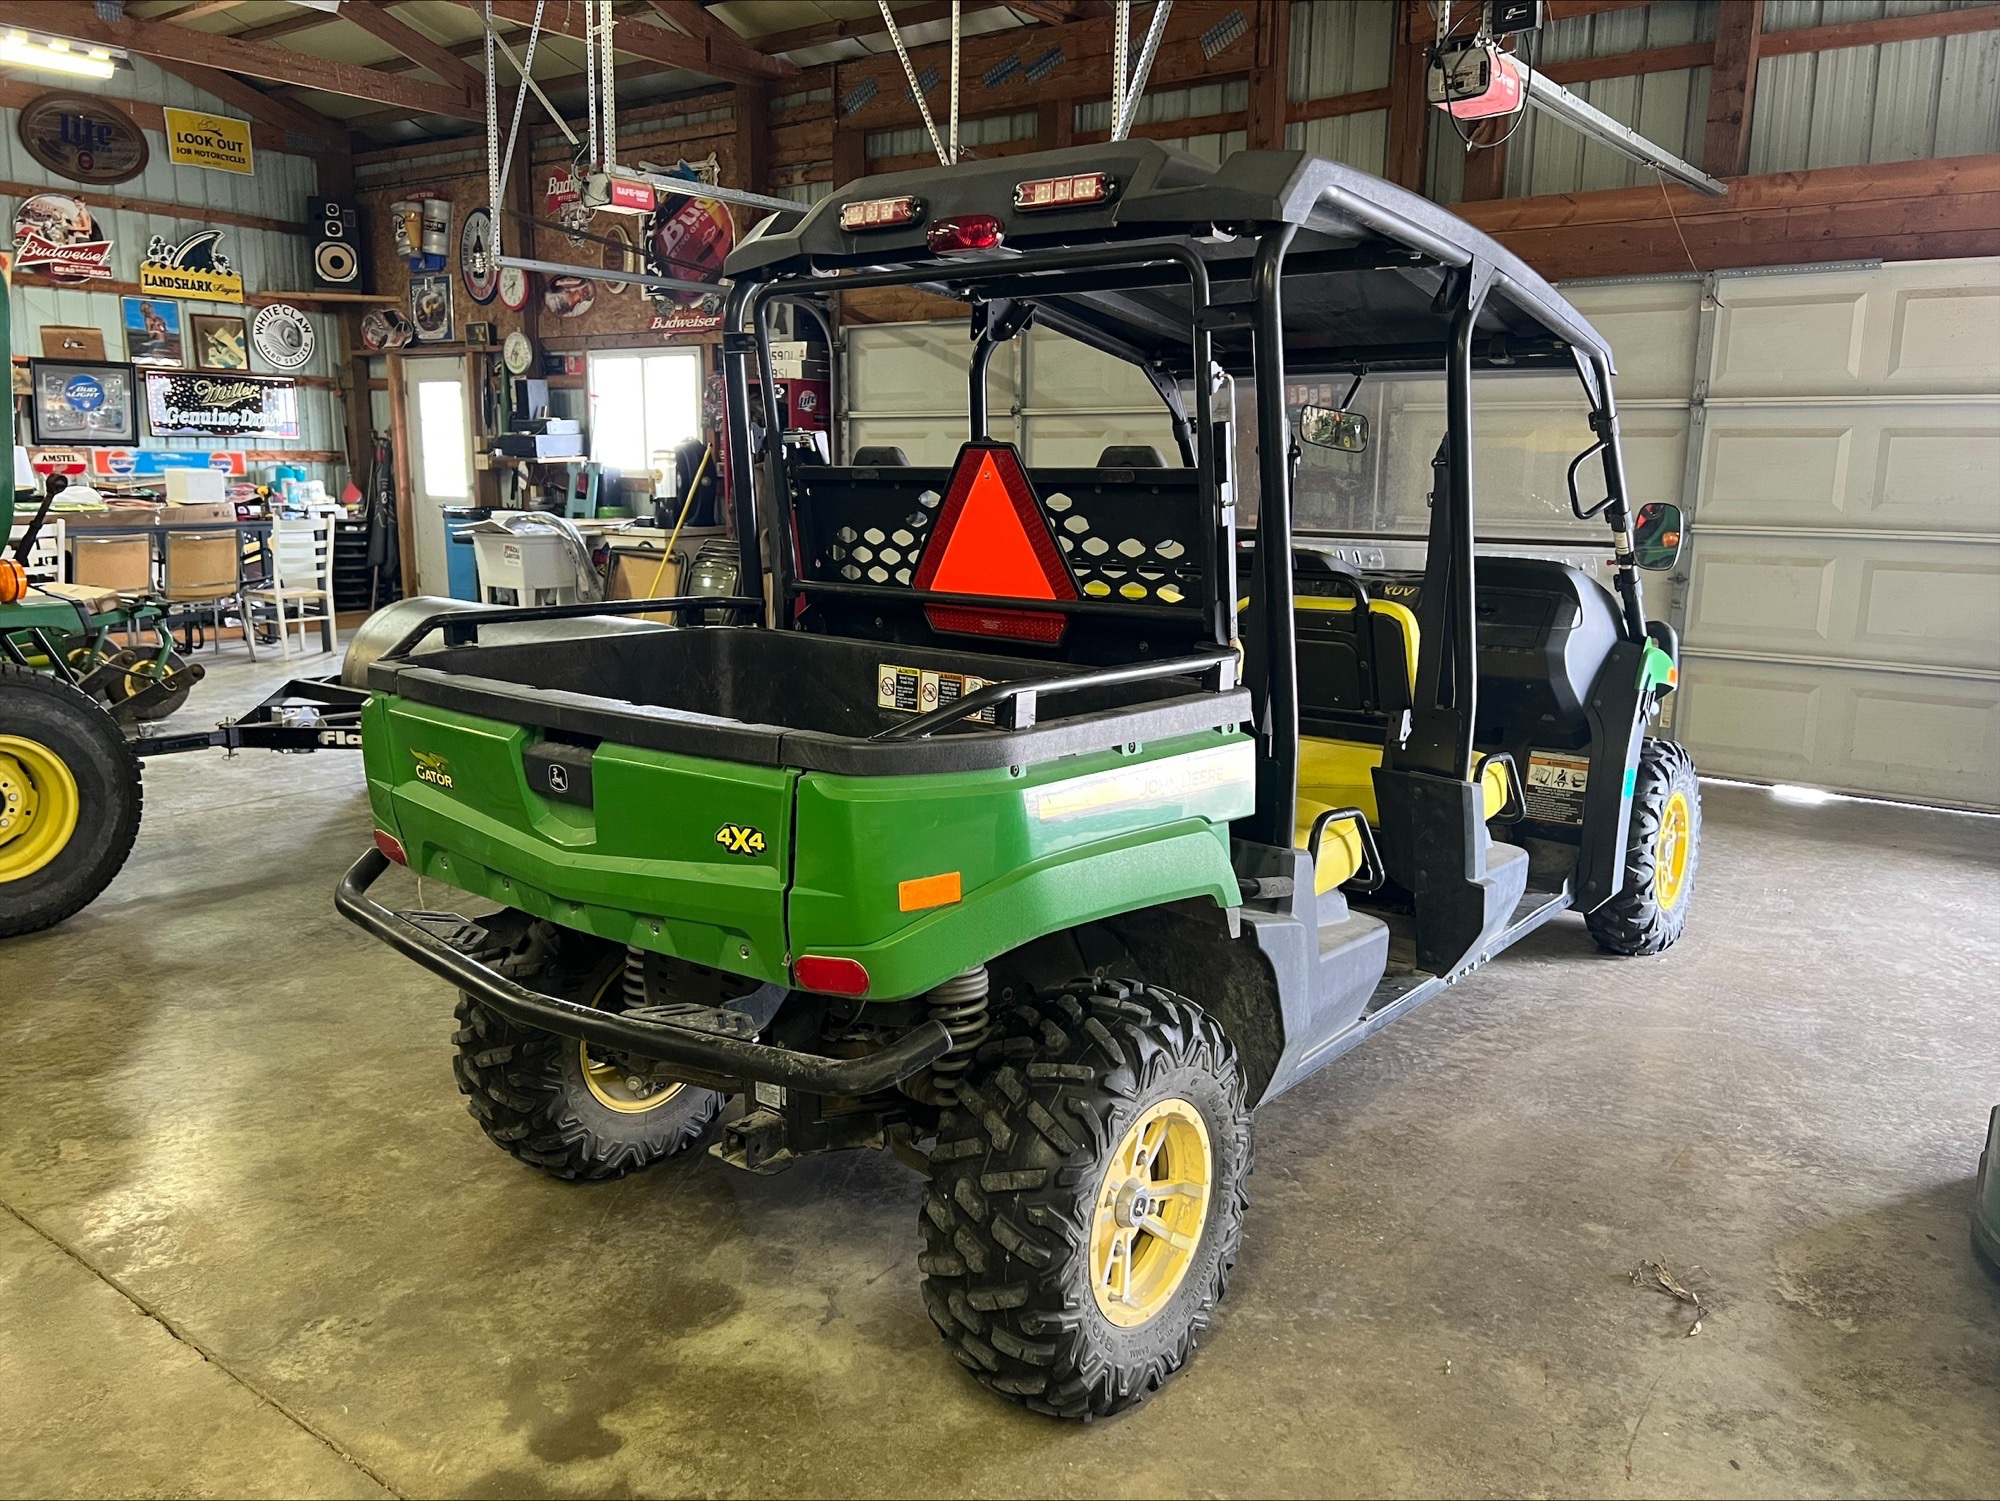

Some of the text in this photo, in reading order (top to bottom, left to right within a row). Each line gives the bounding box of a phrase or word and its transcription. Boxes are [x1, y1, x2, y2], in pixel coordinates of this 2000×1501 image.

[60, 112, 112, 154] Lite
[177, 132, 244, 153] LOOK OUT
[176, 147, 192, 155] FOR
[194, 149, 246, 164] MOTORCYCLES
[616, 187, 650, 199] SAFE-WAY
[21, 240, 111, 261] Budweiser
[144, 274, 213, 293] LANDSHARK
[255, 306, 312, 336] WHITE CLAW
[650, 316, 721, 330] Budweiser
[263, 342, 310, 365] HARD SELTZER
[70, 392, 102, 400] LIGHT
[194, 380, 261, 406] Miller
[165, 407, 282, 427] Genuine Draft
[416, 764, 454, 789] GATOR
[1139, 767, 1224, 797] JOHN DEERE
[716, 826, 765, 853] 4X4
